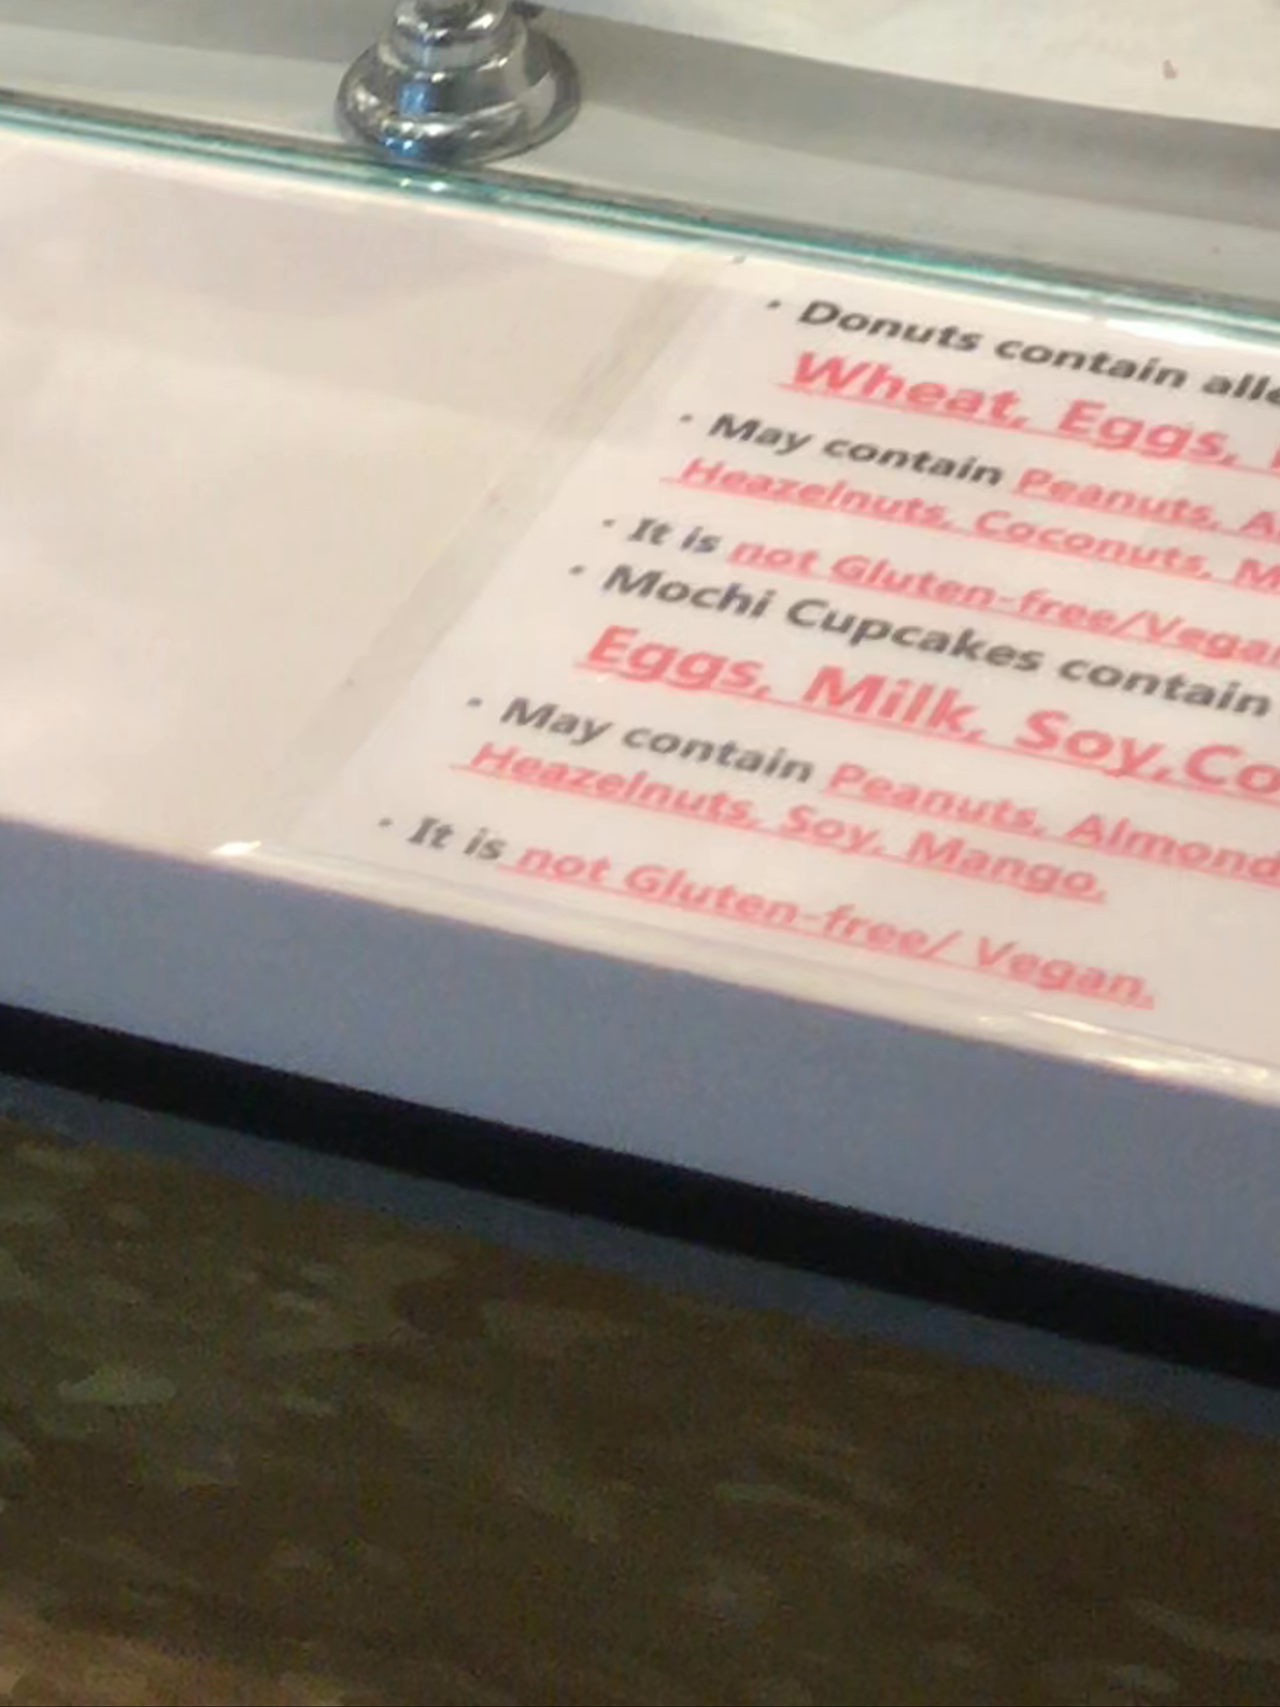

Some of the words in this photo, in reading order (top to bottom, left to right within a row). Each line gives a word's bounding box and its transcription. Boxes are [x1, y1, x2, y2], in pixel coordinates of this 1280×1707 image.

[797, 299, 981, 353] Donuts
[993, 335, 1189, 390] contain
[708, 413, 814, 455] May
[823, 434, 1005, 487] contain
[626, 518, 673, 547] It
[681, 525, 721, 555] is
[726, 539, 821, 578] not
[601, 564, 775, 620] Mochi
[786, 597, 1045, 673] Cupcakes
[1057, 656, 1270, 718] contain
[500, 697, 613, 741] May
[622, 723, 816, 784] contain
[406, 815, 453, 849] It
[462, 824, 508, 863] is
[515, 843, 612, 885] not
